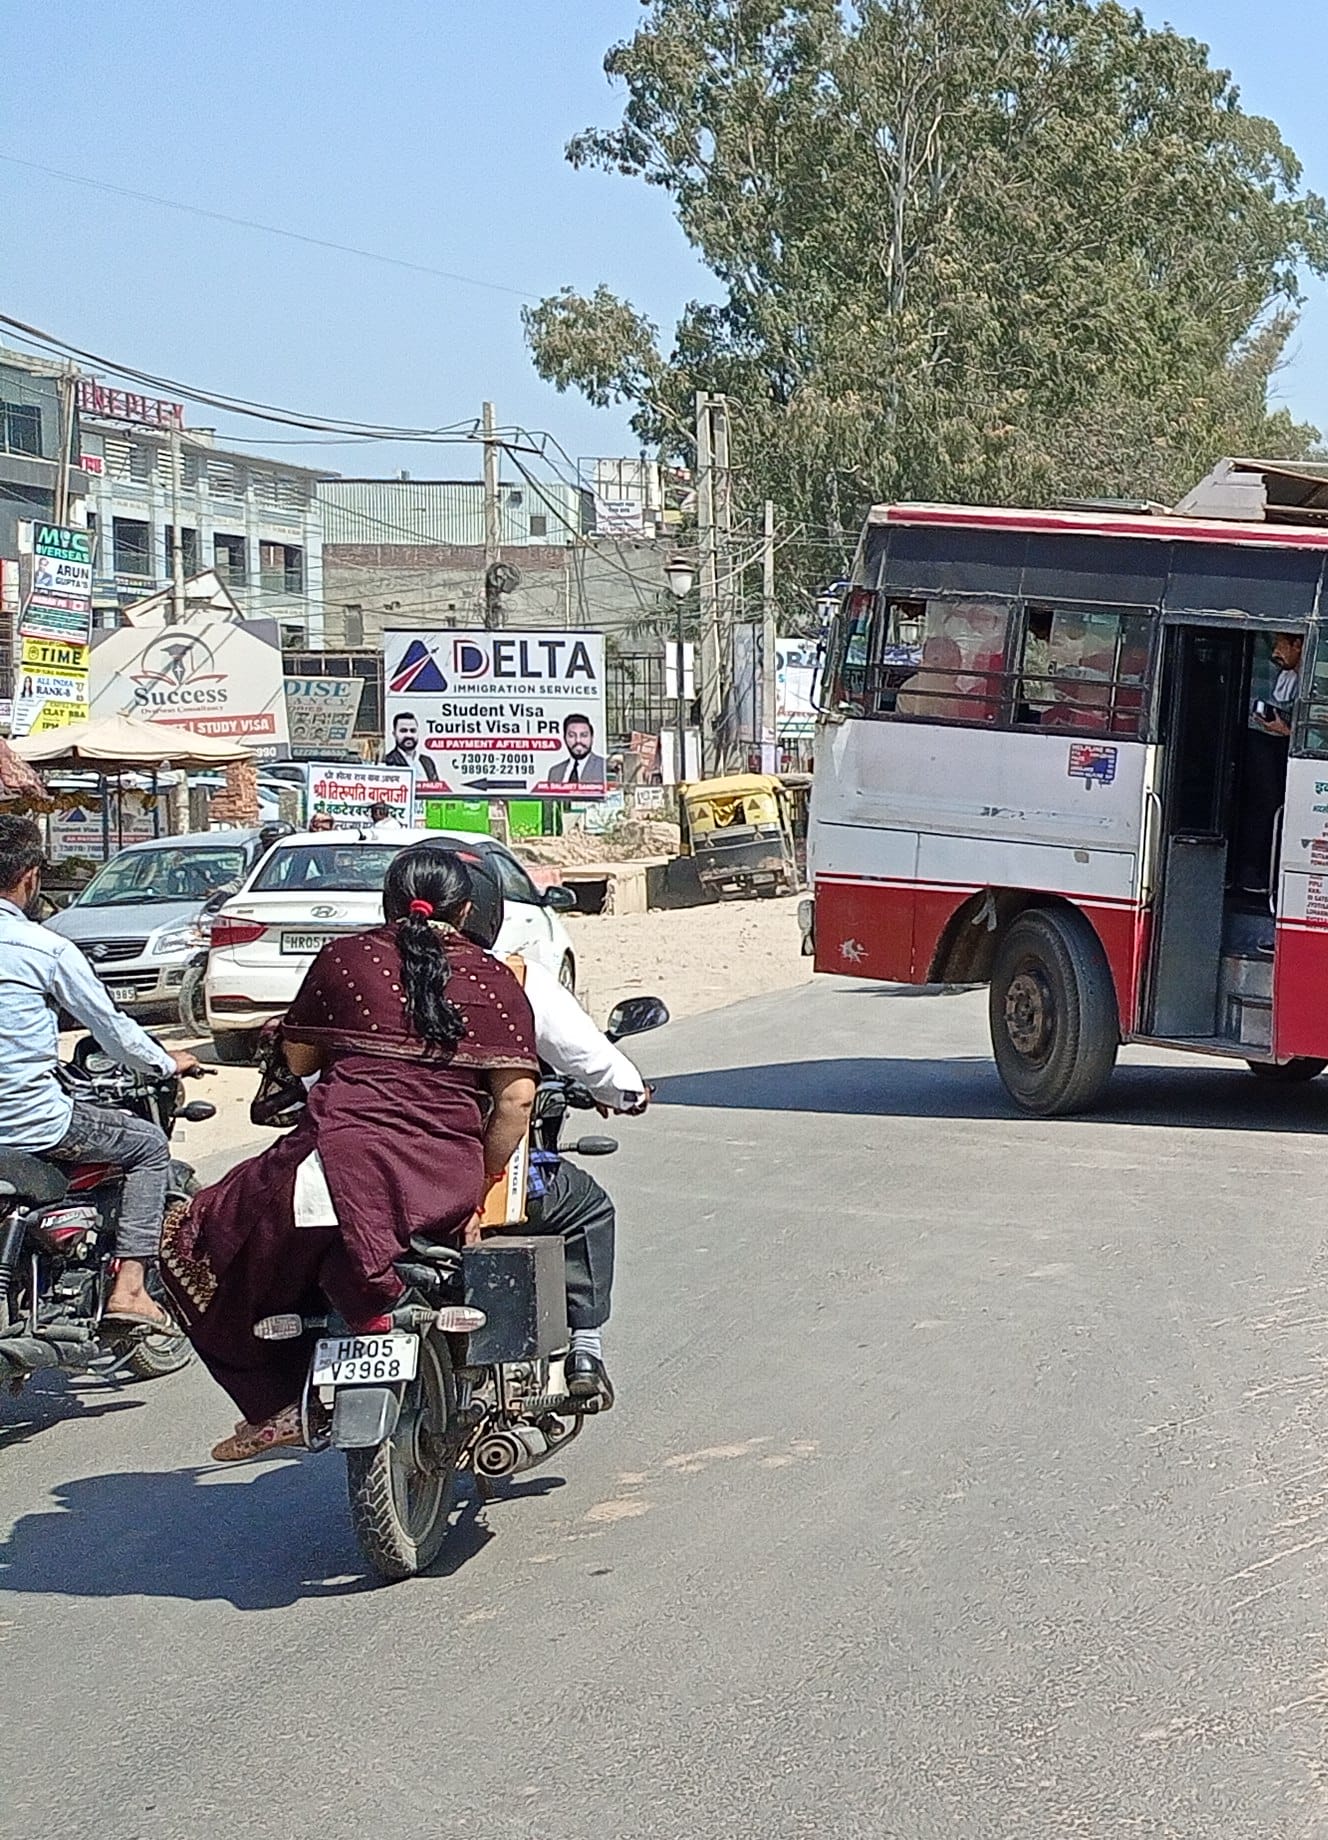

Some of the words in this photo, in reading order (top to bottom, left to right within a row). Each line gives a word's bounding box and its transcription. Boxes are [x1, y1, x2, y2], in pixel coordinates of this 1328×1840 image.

[56, 564, 89, 580] ARUN
[41, 647, 81, 665] TIME
[453, 639, 596, 680] DELTA
[133, 687, 228, 707] Success
[453, 684, 536, 694] IMMIGRATION
[539, 685, 598, 695] SERVICES
[442, 703, 504, 717] Student
[509, 703, 544, 717] Visa
[198, 719, 238, 735] STUDY
[241, 717, 271, 732] VISA
[426, 720, 481, 734] Tourist
[486, 720, 521, 734] Visa
[537, 721, 561, 734] PR
[460, 753, 535, 764] 73070-70001
[511, 1153, 521, 1196] STIGE
[338, 1339, 394, 1360] HR05
[331, 1359, 401, 1381] V3968
